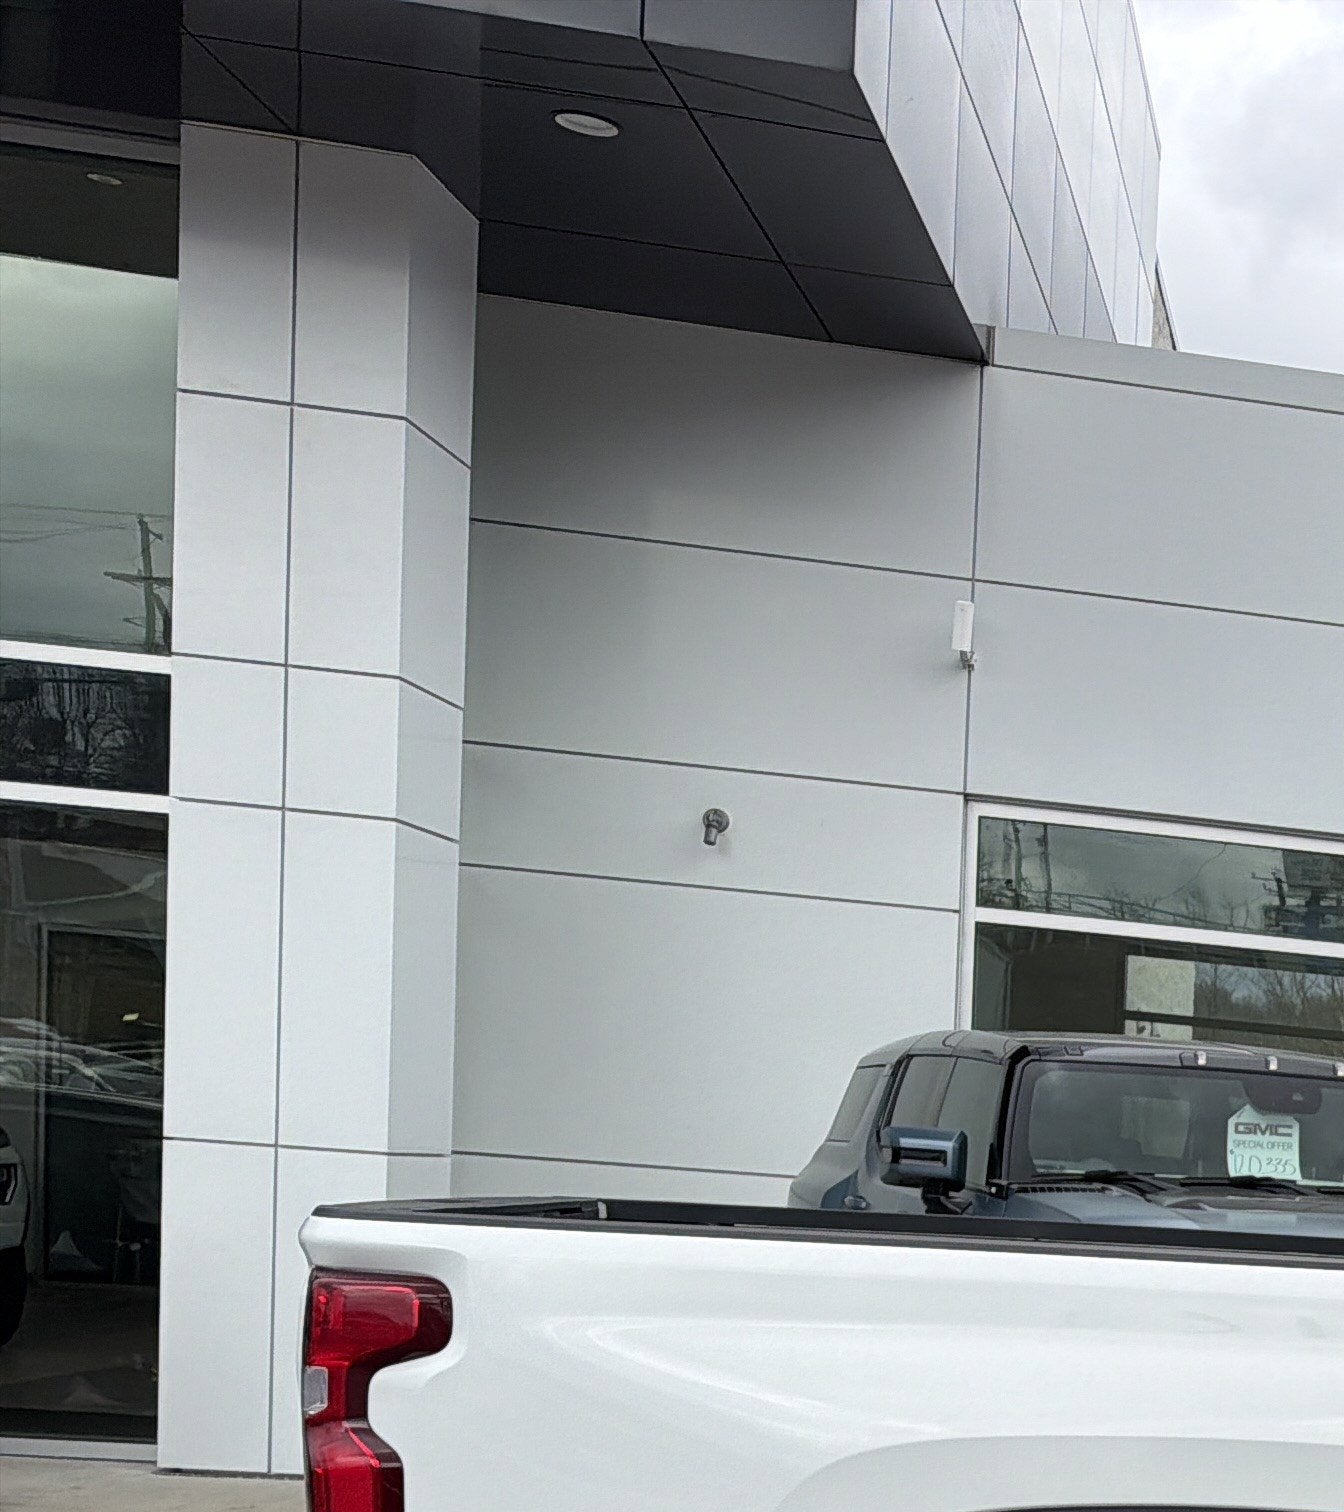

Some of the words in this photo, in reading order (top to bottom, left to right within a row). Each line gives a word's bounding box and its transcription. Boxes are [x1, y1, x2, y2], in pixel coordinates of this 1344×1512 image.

[1234, 1122, 1293, 1137] GMC
[1232, 1139, 1264, 1149] SPECIAL
[1266, 1140, 1294, 1151] OFFER
